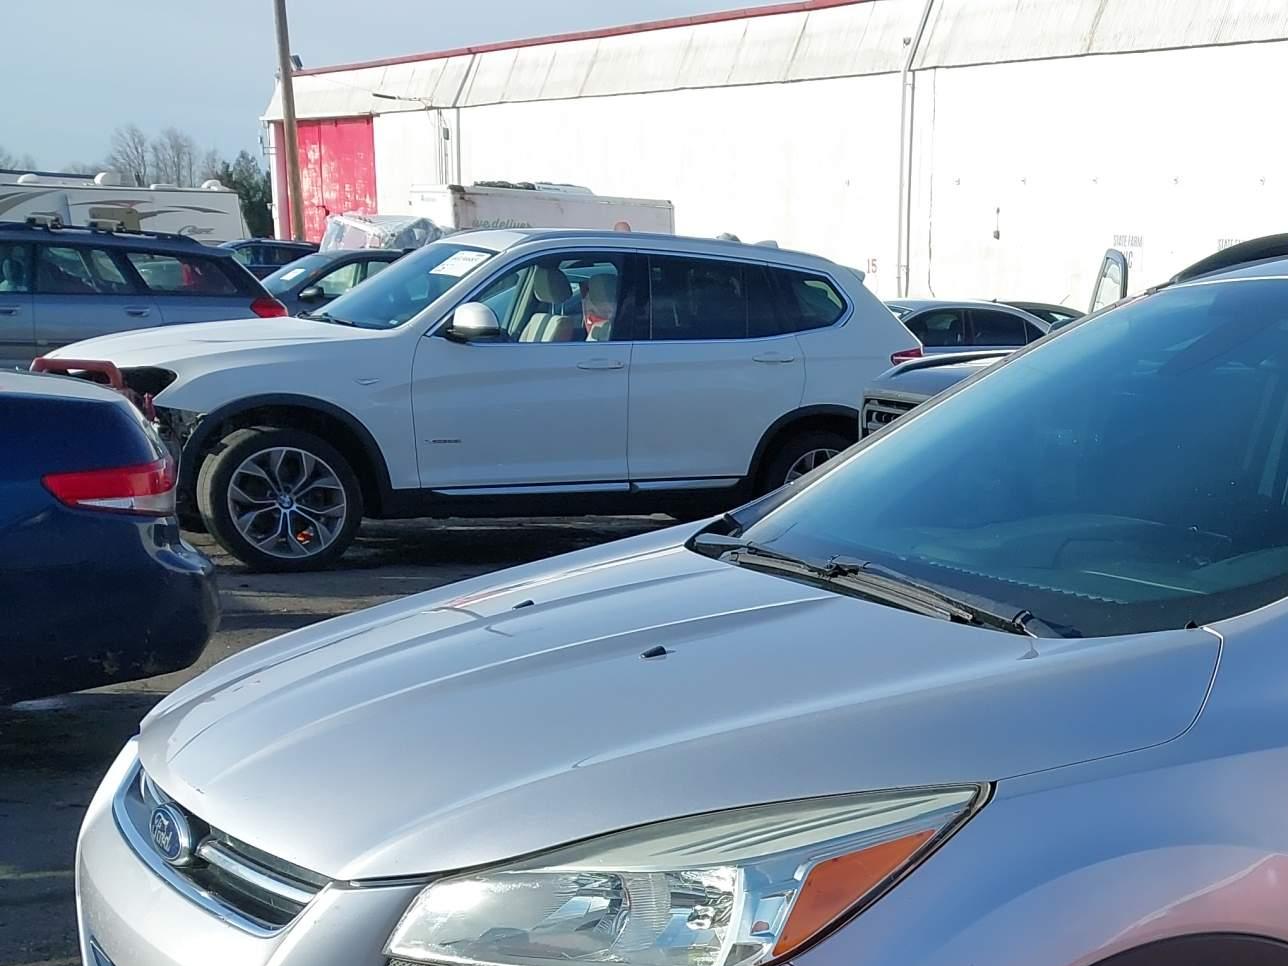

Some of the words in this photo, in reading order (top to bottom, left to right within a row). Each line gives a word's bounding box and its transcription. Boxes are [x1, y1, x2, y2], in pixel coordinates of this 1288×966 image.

[1113, 234, 1127, 247] STATE
[866, 258, 878, 274] 15
[153, 812, 172, 851] Ford
